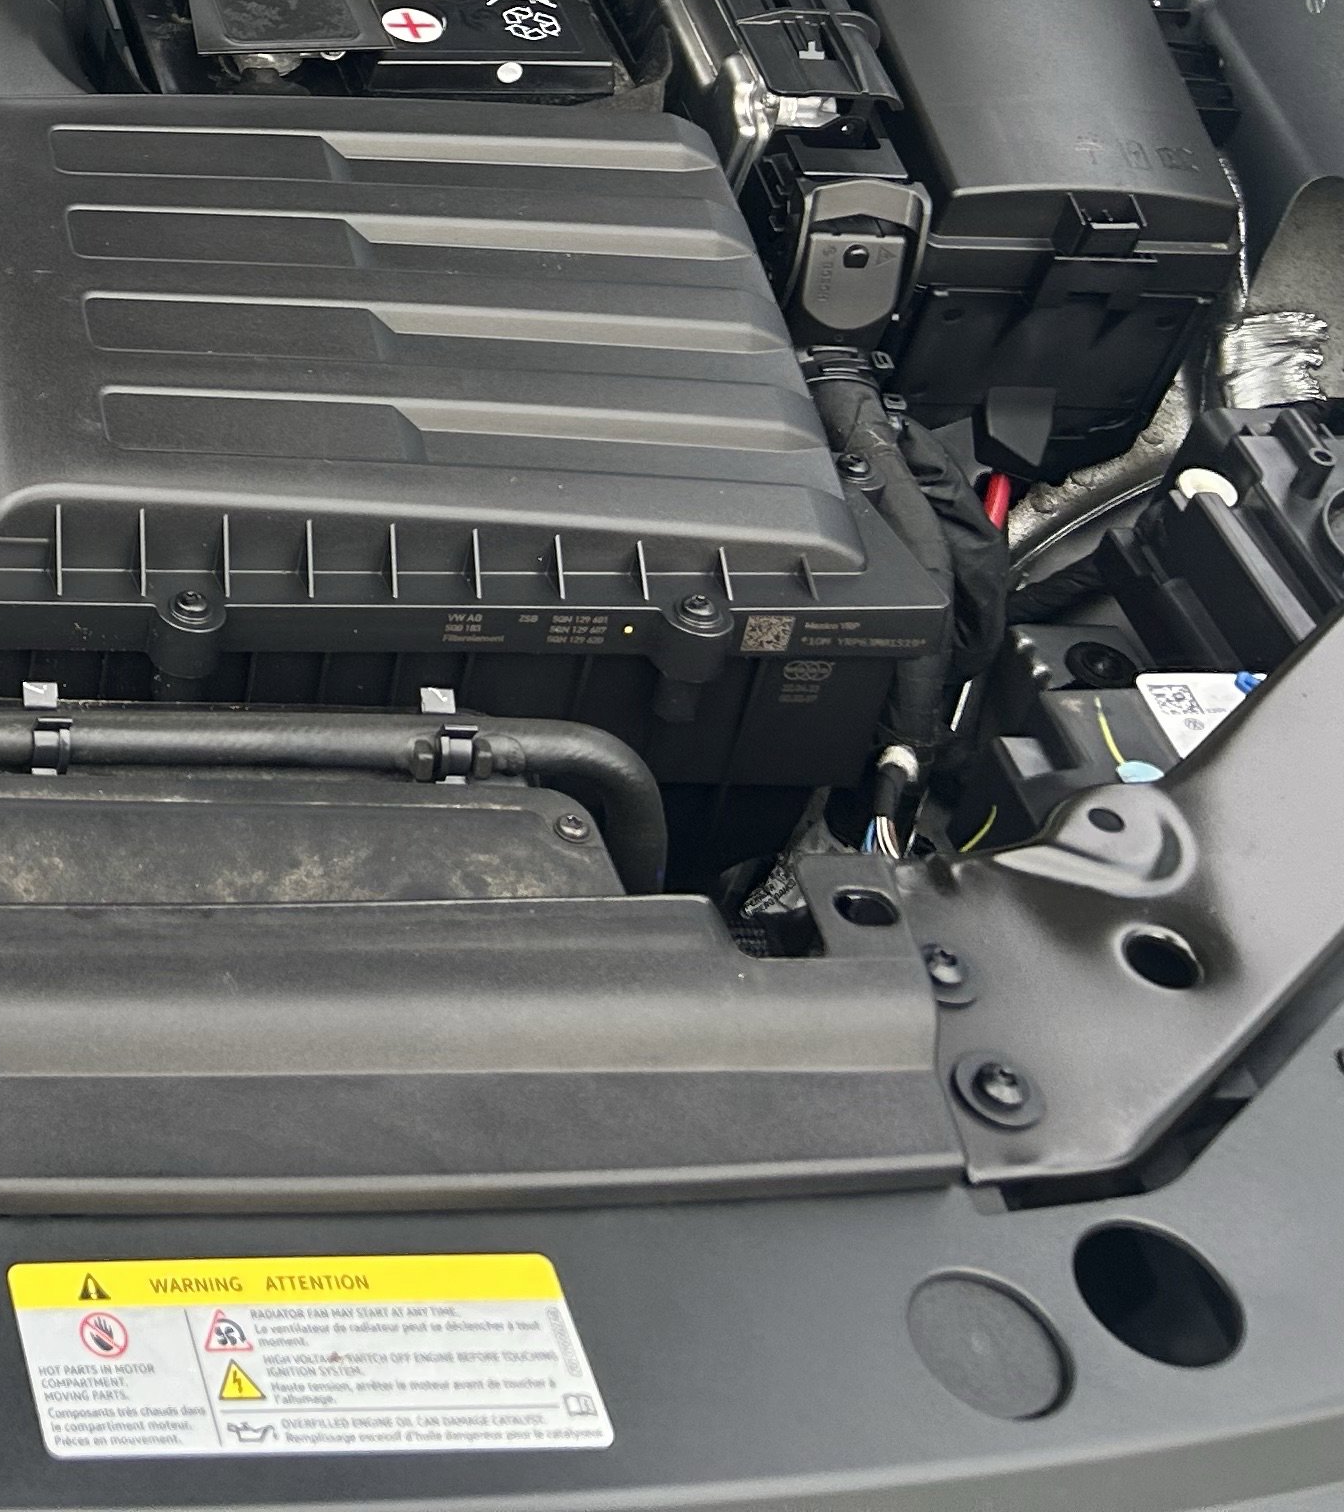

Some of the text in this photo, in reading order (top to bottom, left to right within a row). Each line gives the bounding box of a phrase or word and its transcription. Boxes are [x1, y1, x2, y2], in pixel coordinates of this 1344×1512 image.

[148, 1274, 370, 1294] WARNING ATTENTION
[250, 1309, 305, 1320] RADIATOR
[357, 1307, 389, 1318] START
[38, 1366, 62, 1376] HOT
[64, 1365, 97, 1375] PARTS
[115, 1364, 155, 1374] MOTOR
[44, 1390, 89, 1402] MOVING
